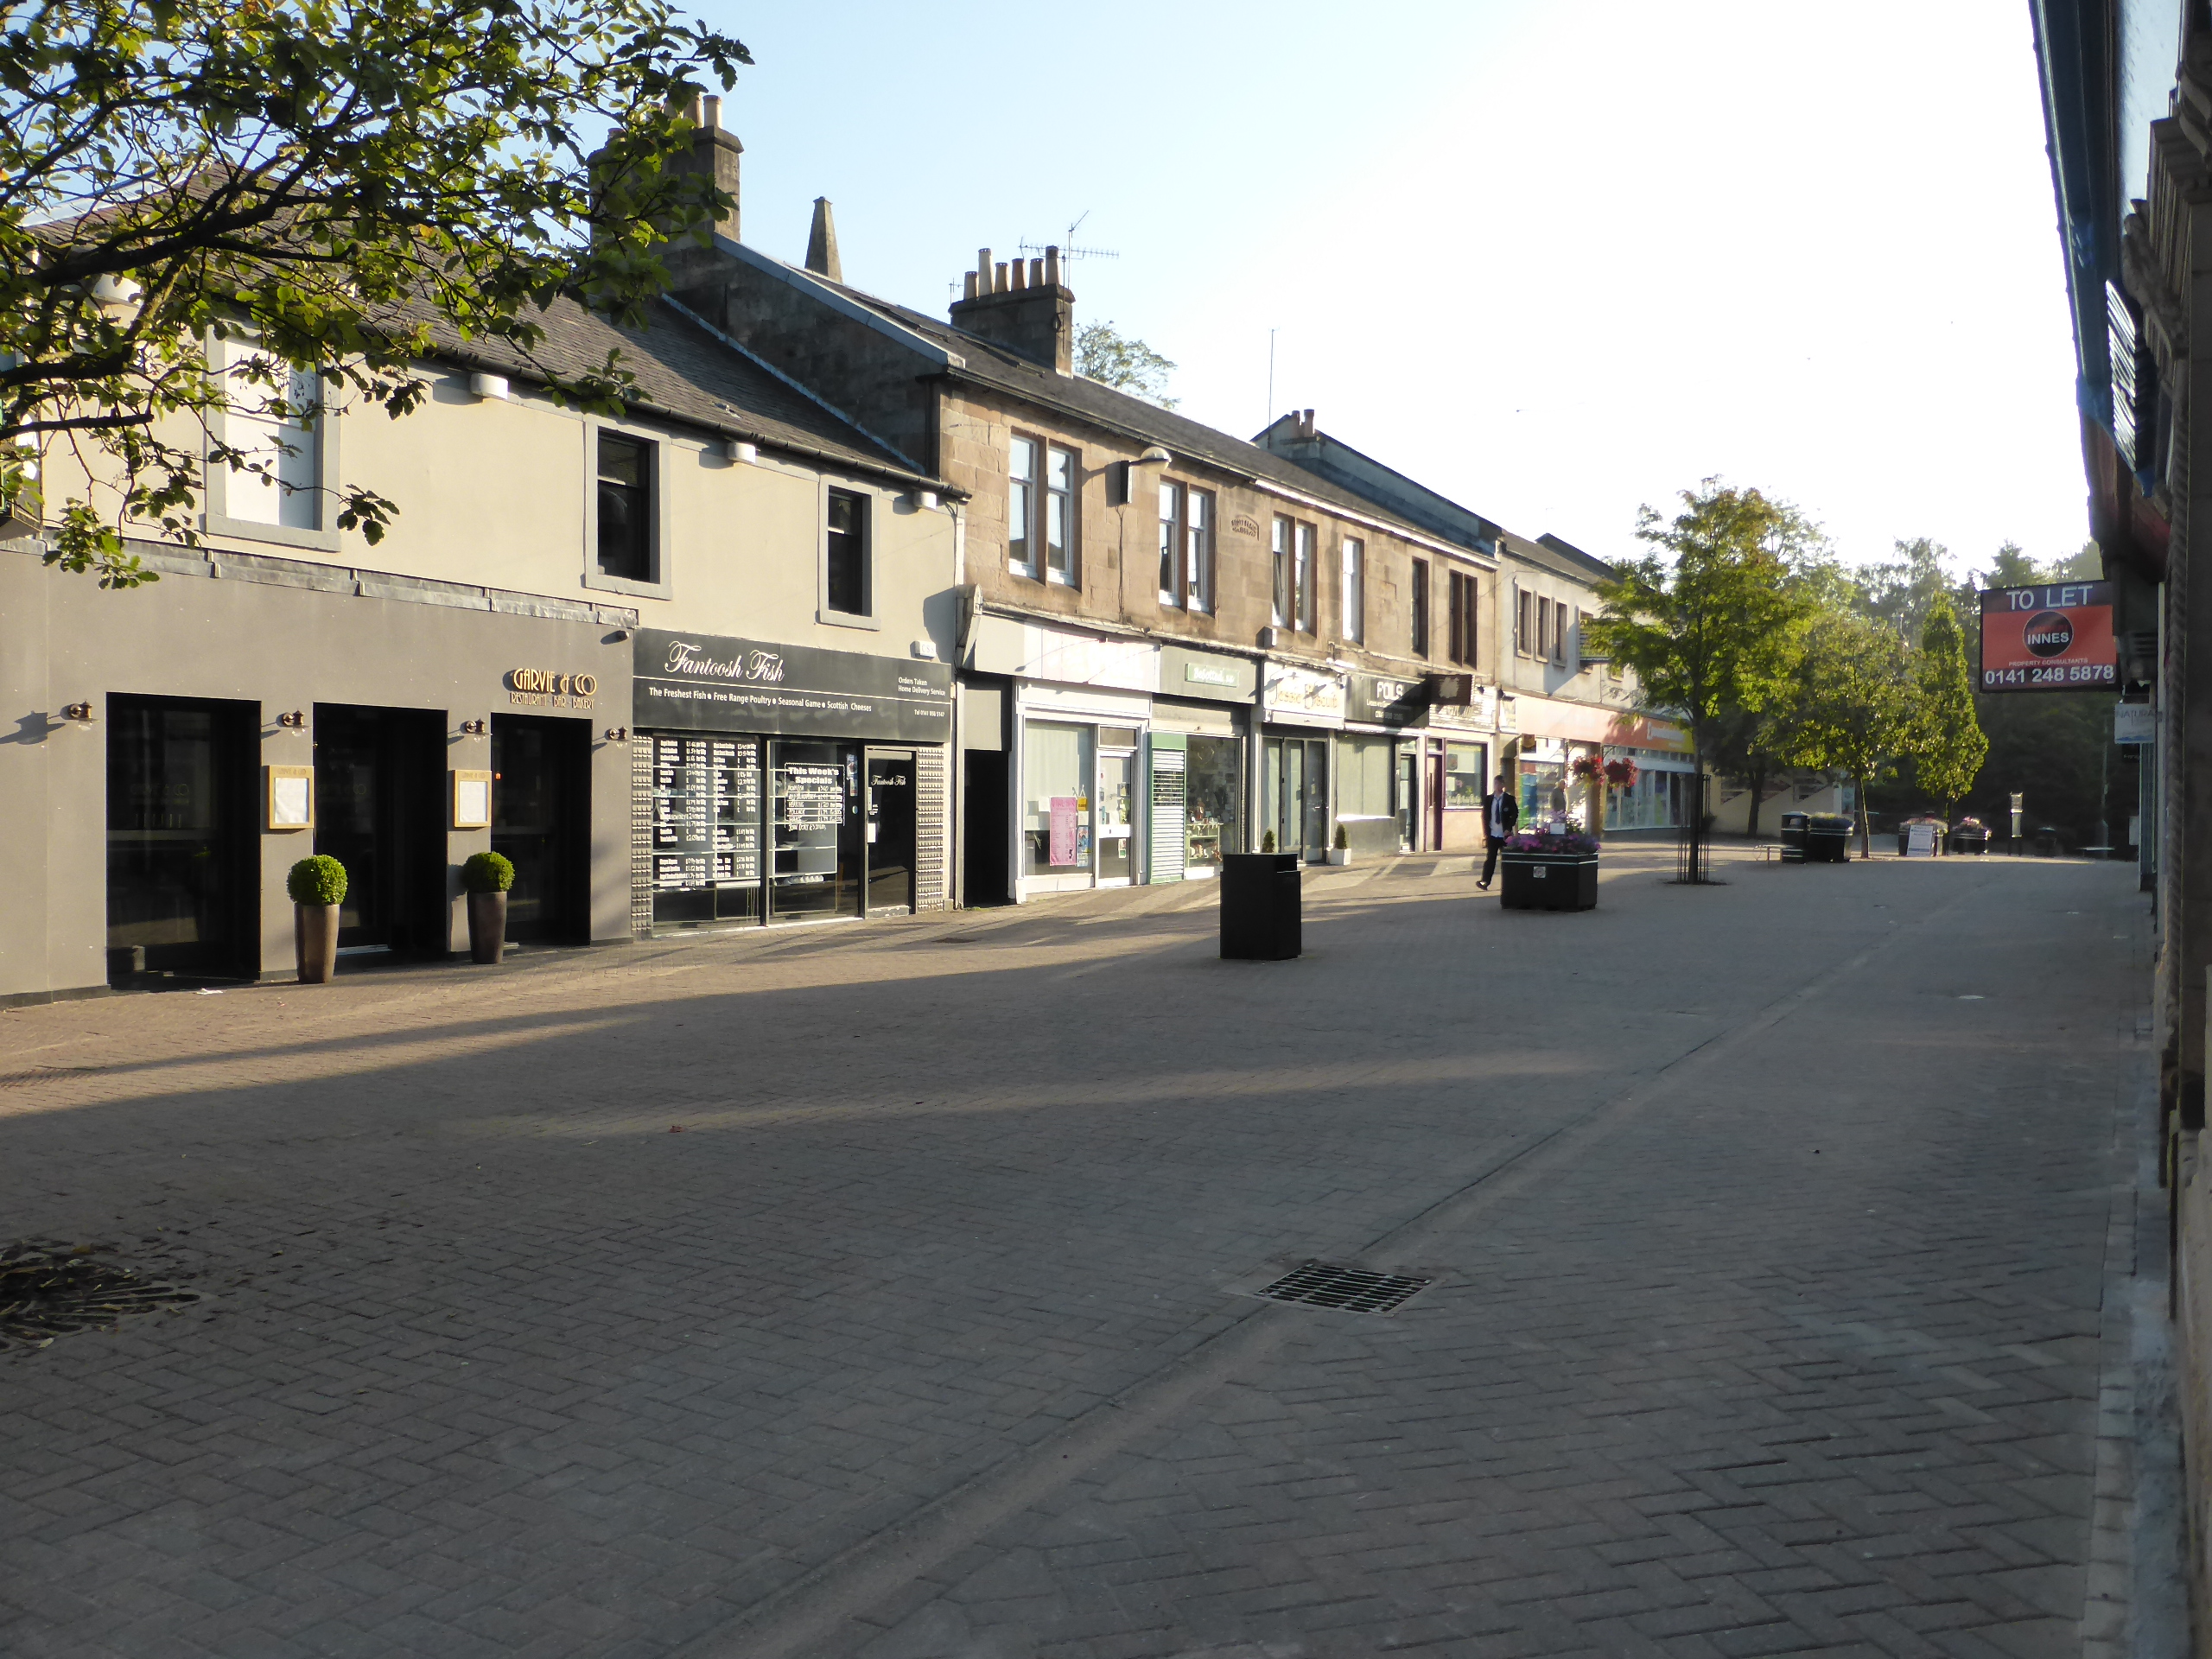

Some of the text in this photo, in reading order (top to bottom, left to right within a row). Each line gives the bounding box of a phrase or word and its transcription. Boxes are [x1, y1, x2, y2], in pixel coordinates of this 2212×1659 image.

[2006, 584, 2093, 610] TO LET
[2027, 632, 2069, 645] INNES
[664, 641, 785, 682] Fantoosh Fish
[513, 668, 596, 696] GARVIE & CO
[1985, 664, 2113, 684] 0141 248 5878
[511, 692, 547, 706] RESTAURANT
[553, 696, 566, 708] BAR
[649, 687, 872, 712] The Freshest Fish Free Range Poultry Seasonal Game Scottish Cheeses
[912, 686, 930, 696] Delivery
[931, 688, 945, 696] Service
[788, 766, 839, 776] This Week's
